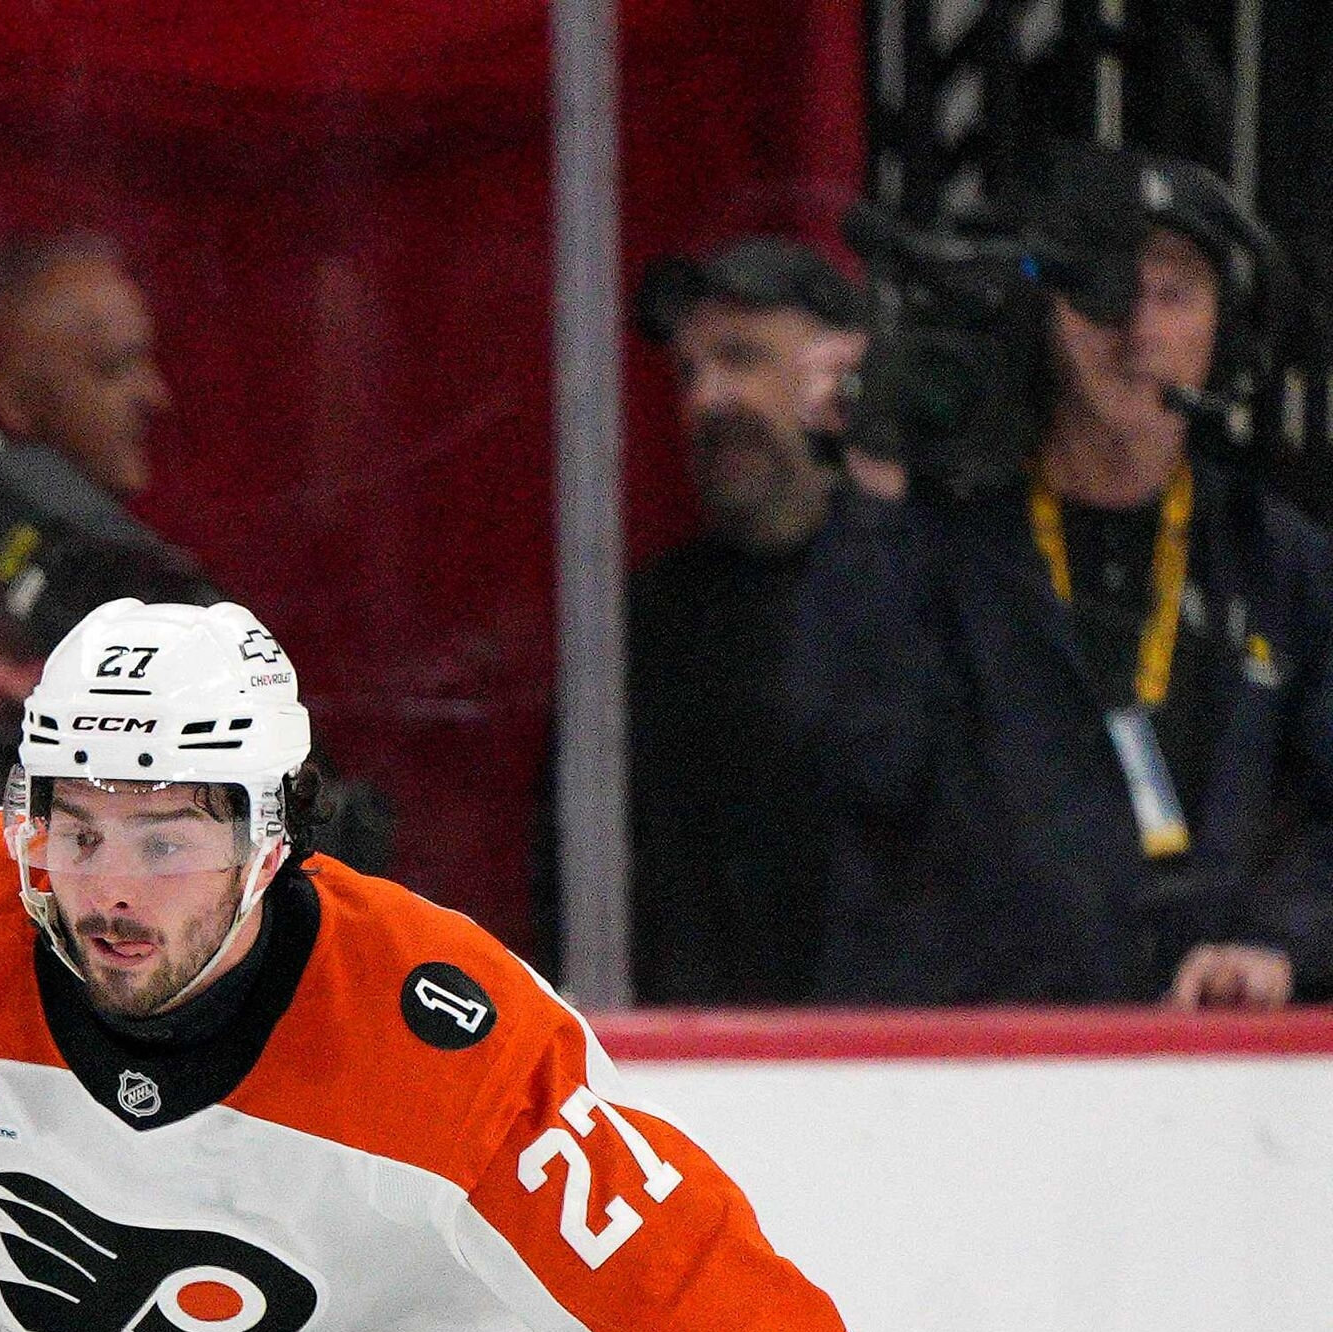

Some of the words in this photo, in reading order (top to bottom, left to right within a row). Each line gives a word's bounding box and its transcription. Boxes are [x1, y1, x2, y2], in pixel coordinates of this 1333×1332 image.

[96, 645, 159, 678] 27
[72, 716, 158, 733] CCM
[415, 977, 488, 1033] 1
[517, 1085, 683, 1270] 27
